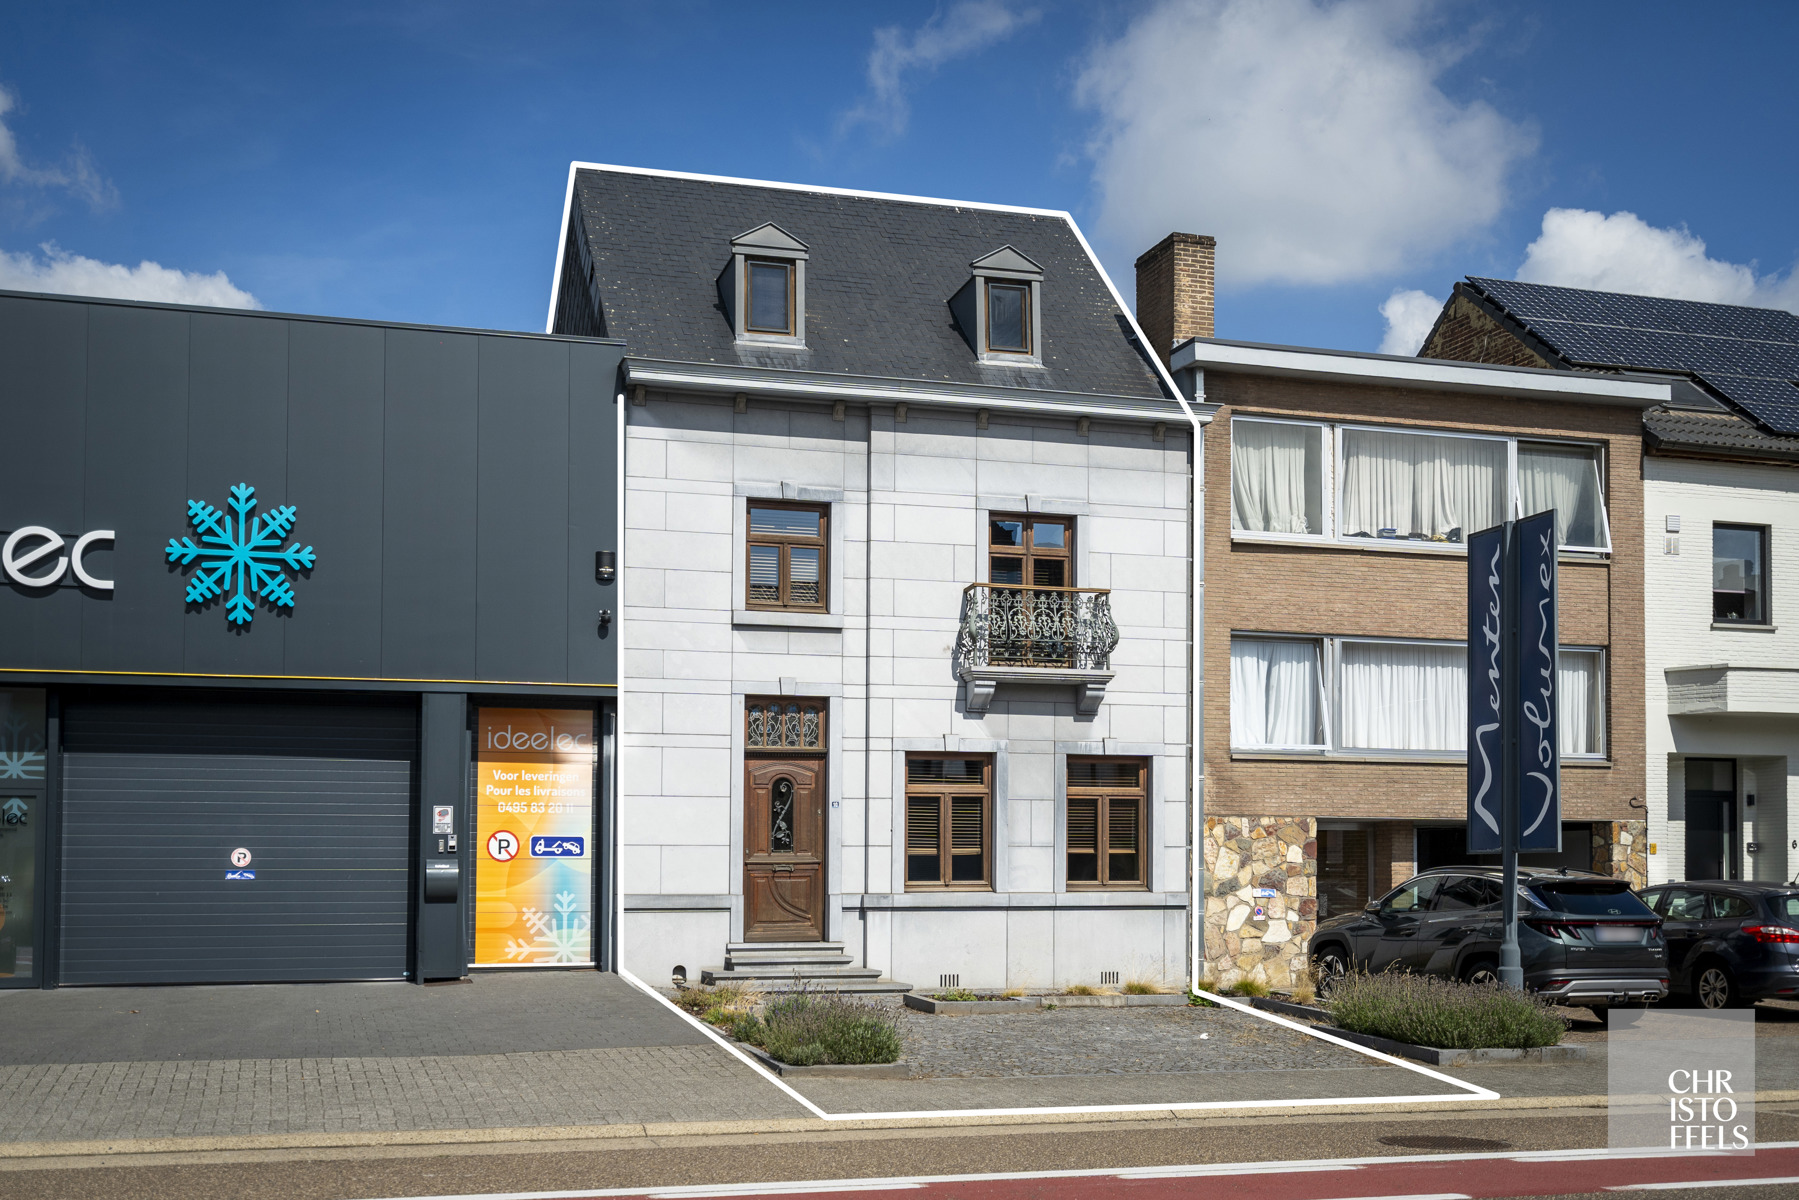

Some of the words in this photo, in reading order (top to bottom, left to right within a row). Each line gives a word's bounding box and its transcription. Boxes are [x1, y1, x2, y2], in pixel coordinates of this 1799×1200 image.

[2, 525, 115, 590] ec
[1523, 528, 1554, 837] Volumex
[487, 725, 587, 750] ideelec
[493, 769, 519, 781] Voor
[521, 770, 579, 785] leveringen
[486, 784, 513, 796] Pour
[515, 785, 531, 796] les
[533, 785, 586, 797] livraisons
[0, 808, 28, 826] lec
[497, 802, 528, 814] 0495
[530, 802, 545, 814] 83
